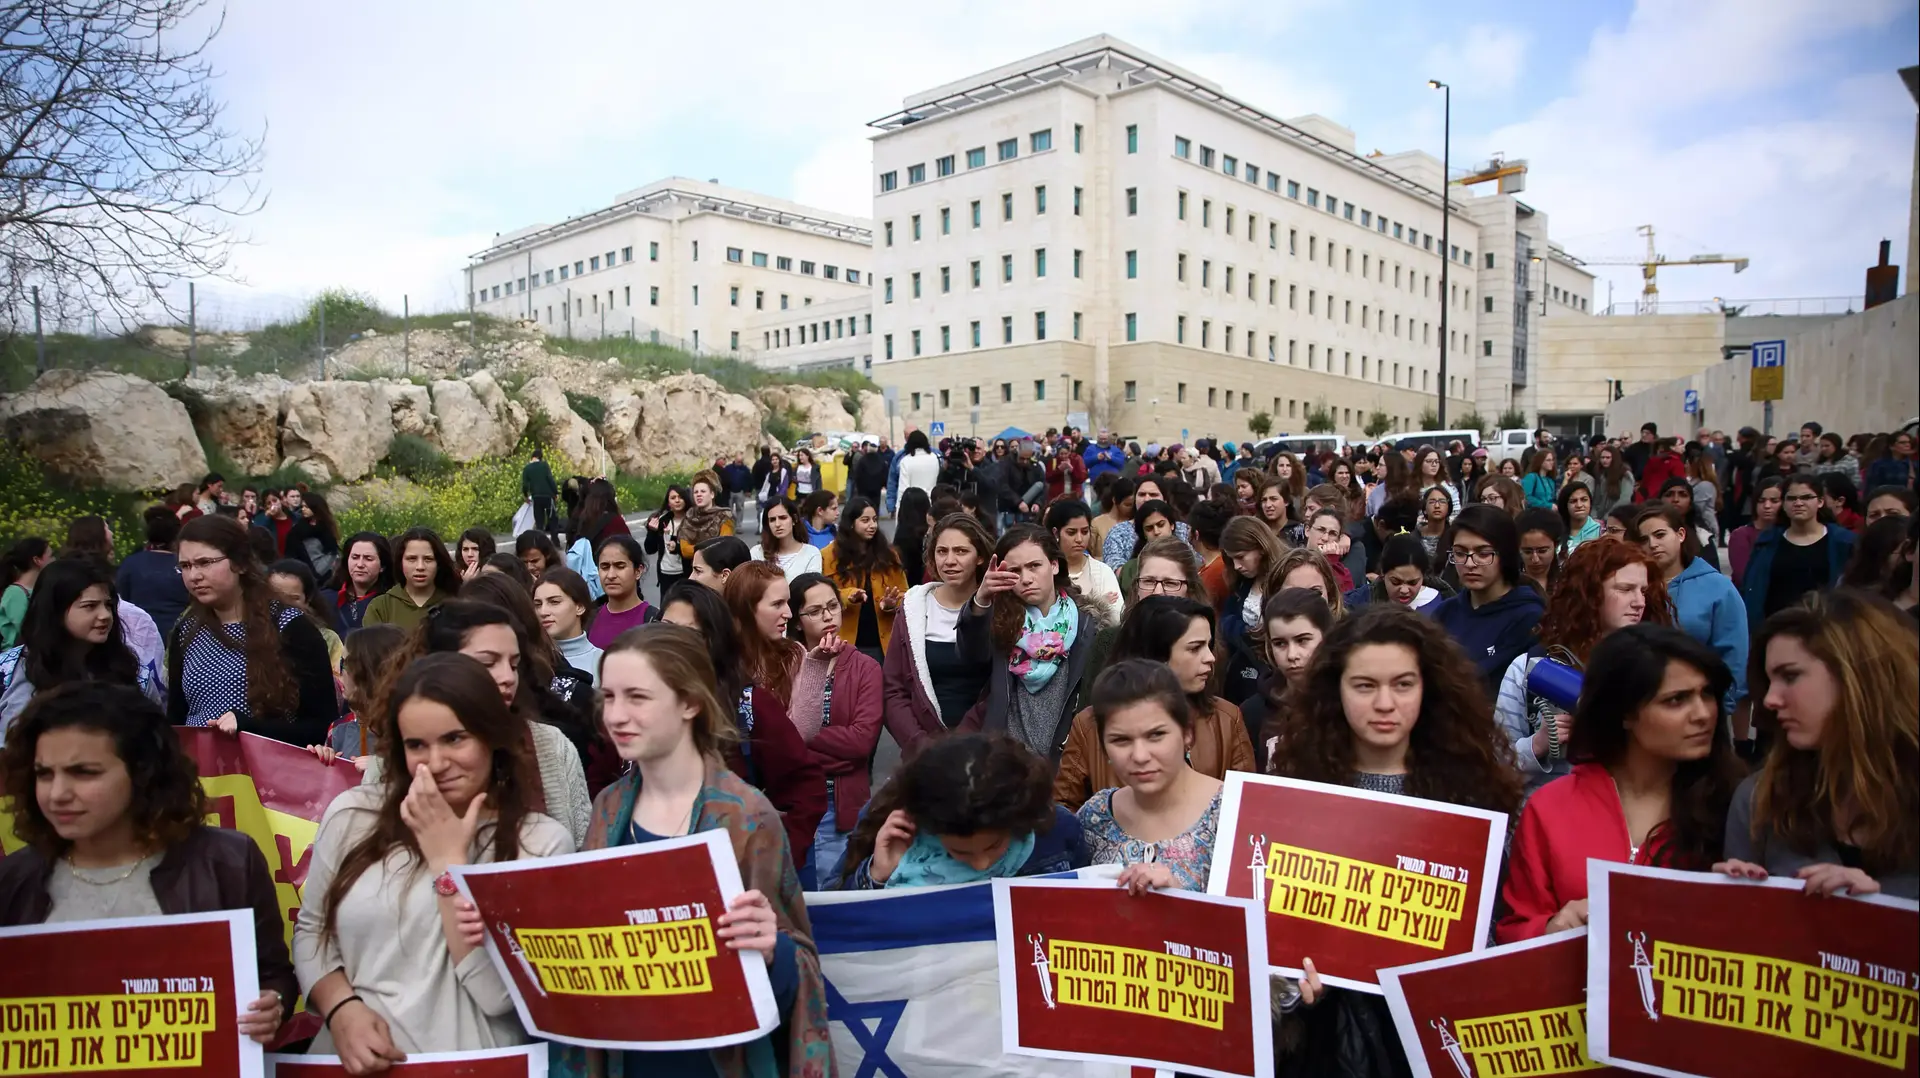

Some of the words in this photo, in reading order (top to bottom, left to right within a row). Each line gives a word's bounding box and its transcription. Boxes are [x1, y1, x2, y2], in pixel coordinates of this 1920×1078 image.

[1272, 850, 1339, 886] ההסתה
[1395, 854, 1426, 874] ממשיך
[1428, 861, 1455, 880] הטרור
[1458, 866, 1469, 884] גל
[1345, 865, 1375, 894] את
[1381, 873, 1460, 913] מפסיקים
[659, 905, 691, 920] הטרור
[692, 902, 707, 918] גל
[1281, 884, 1336, 919] הטרור
[1341, 898, 1371, 927] את
[624, 908, 658, 925] ממשיך
[1377, 905, 1444, 942] עוצרים
[522, 935, 584, 959] ההסתה
[587, 933, 618, 959] את
[622, 924, 709, 958] מפסיקים
[1163, 940, 1191, 958] ממשיך
[1054, 946, 1114, 975] ההסתה
[1123, 953, 1147, 979] את
[1194, 947, 1220, 964] הטרור
[1222, 953, 1233, 968] גל
[1659, 948, 1744, 988] ההסתה
[1818, 950, 1860, 976] ממשיך
[122, 978, 159, 995] ממשיך
[163, 977, 197, 993] הטרור
[201, 976, 214, 992] גל
[543, 965, 596, 990] הטרור
[599, 965, 629, 991] את
[633, 960, 704, 989] עוצרים
[1156, 958, 1229, 996] מפסיקים
[1754, 962, 1792, 996] את
[1865, 962, 1906, 988] הטרור
[1064, 976, 1116, 1005] הטרור
[1124, 983, 1149, 1010] את
[1672, 985, 1745, 1023] הטרור
[1804, 970, 1919, 1027] מפסיקים
[67, 1001, 101, 1030] את
[112, 998, 209, 1029] מפסיקים
[1158, 988, 1218, 1023] עוצרים
[1755, 998, 1793, 1033] את
[1461, 1017, 1535, 1048] ההסתה
[1540, 1011, 1574, 1039] את
[1804, 1008, 1899, 1060] עוצרים
[70, 1036, 104, 1066] את
[115, 1032, 196, 1063] עוצרים
[1480, 1047, 1545, 1075] הטרור
[1550, 1042, 1584, 1069] את
